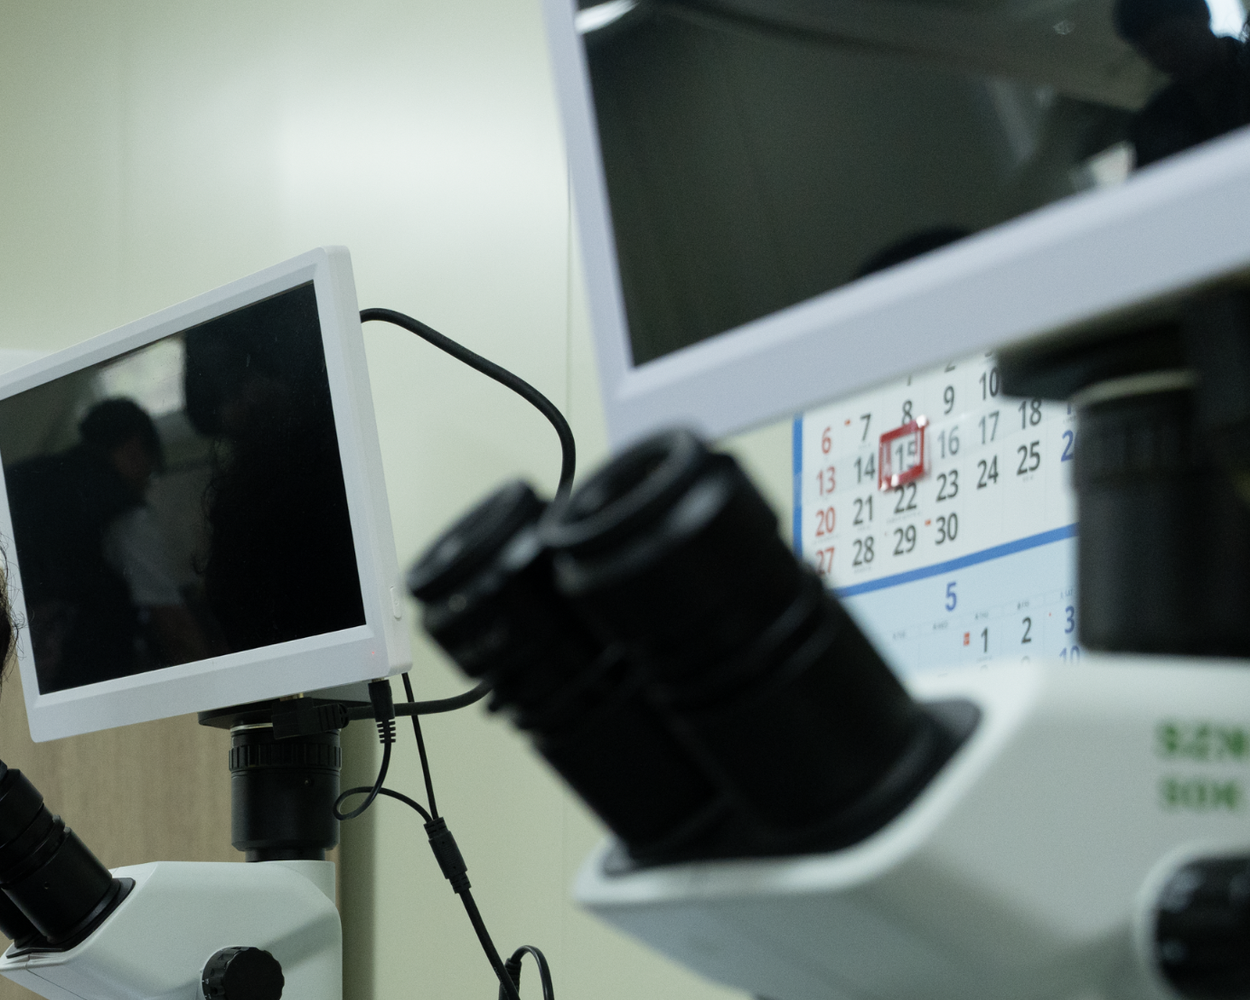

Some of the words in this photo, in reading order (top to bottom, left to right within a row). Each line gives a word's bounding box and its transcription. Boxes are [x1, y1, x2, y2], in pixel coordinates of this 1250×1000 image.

[816, 466, 836, 496] 13
[854, 452, 876, 484] 14
[937, 425, 960, 460] 16
[978, 410, 1000, 446] 17
[1018, 399, 1042, 430] 18
[821, 426, 832, 455] 6
[860, 412, 872, 442] 7
[902, 399, 913, 426] 8
[943, 385, 955, 416] 9
[979, 367, 999, 401] 10
[815, 506, 836, 538] 20
[853, 494, 874, 526] 21
[893, 482, 918, 514] 22
[935, 469, 959, 502] 23
[977, 454, 999, 490] 24
[1016, 440, 1041, 477] 25
[815, 546, 836, 577] 27
[852, 535, 875, 568] 28
[893, 524, 917, 557] 29
[935, 513, 959, 546] 30
[945, 581, 957, 612] 5
[980, 626, 989, 654] 1
[1021, 616, 1032, 645] 2
[1064, 605, 1075, 634] 3
